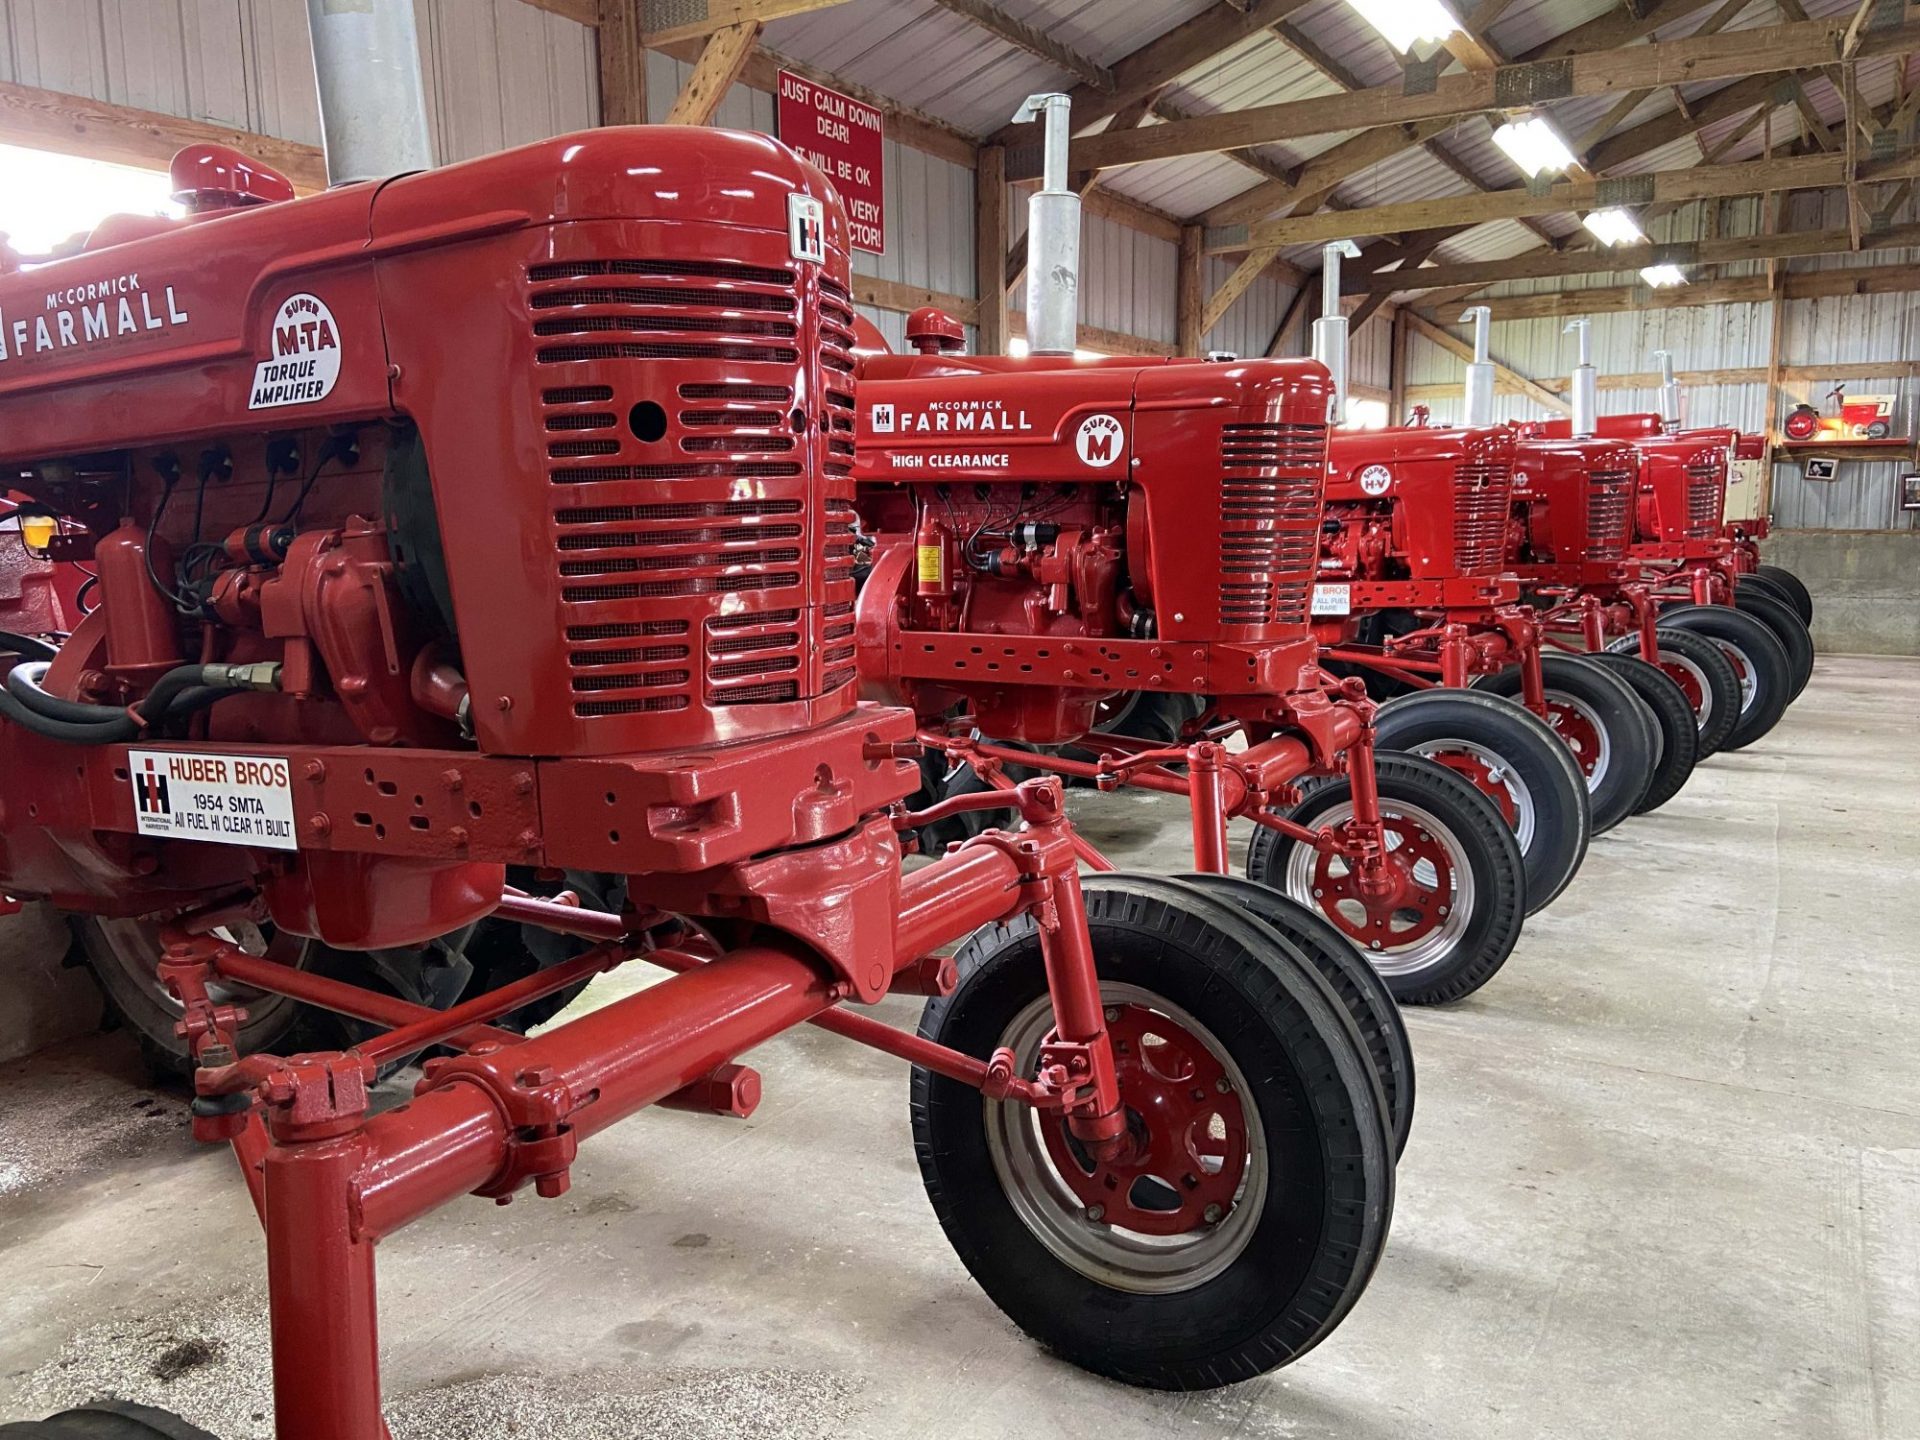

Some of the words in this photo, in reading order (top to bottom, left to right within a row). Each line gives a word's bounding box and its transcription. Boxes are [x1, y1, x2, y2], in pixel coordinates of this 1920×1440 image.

[781, 78, 811, 106] JUST
[814, 91, 846, 119] CALM
[849, 104, 881, 133] DOWN
[817, 116, 850, 145] DEAR!
[808, 150, 835, 175] WILL
[837, 160, 852, 180] BE
[855, 166, 871, 187] OK
[850, 198, 880, 224] VERY
[848, 221, 881, 248] CTOR!
[12, 286, 189, 356] FARMALL
[284, 298, 320, 319] SUPER
[263, 358, 316, 384] TORQUE
[253, 380, 324, 406] AMPLIFIER
[900, 410, 1032, 432] FARMALL
[1082, 417, 1119, 435] SUPER
[1086, 434, 1112, 461] M
[892, 454, 923, 467] HIGH
[928, 454, 1009, 468] CLEARANCE
[1364, 467, 1388, 479] SUPER
[1322, 586, 1348, 595] BROS
[169, 757, 228, 783] HUBER
[234, 761, 288, 788] BROS
[193, 794, 224, 811] 1954
[229, 796, 265, 815] SMTA
[187, 812, 209, 830] FUEL
[210, 816, 220, 832] HI
[223, 817, 251, 835] CLEAR
[254, 818, 263, 835] 11
[266, 819, 290, 838] BUILT
